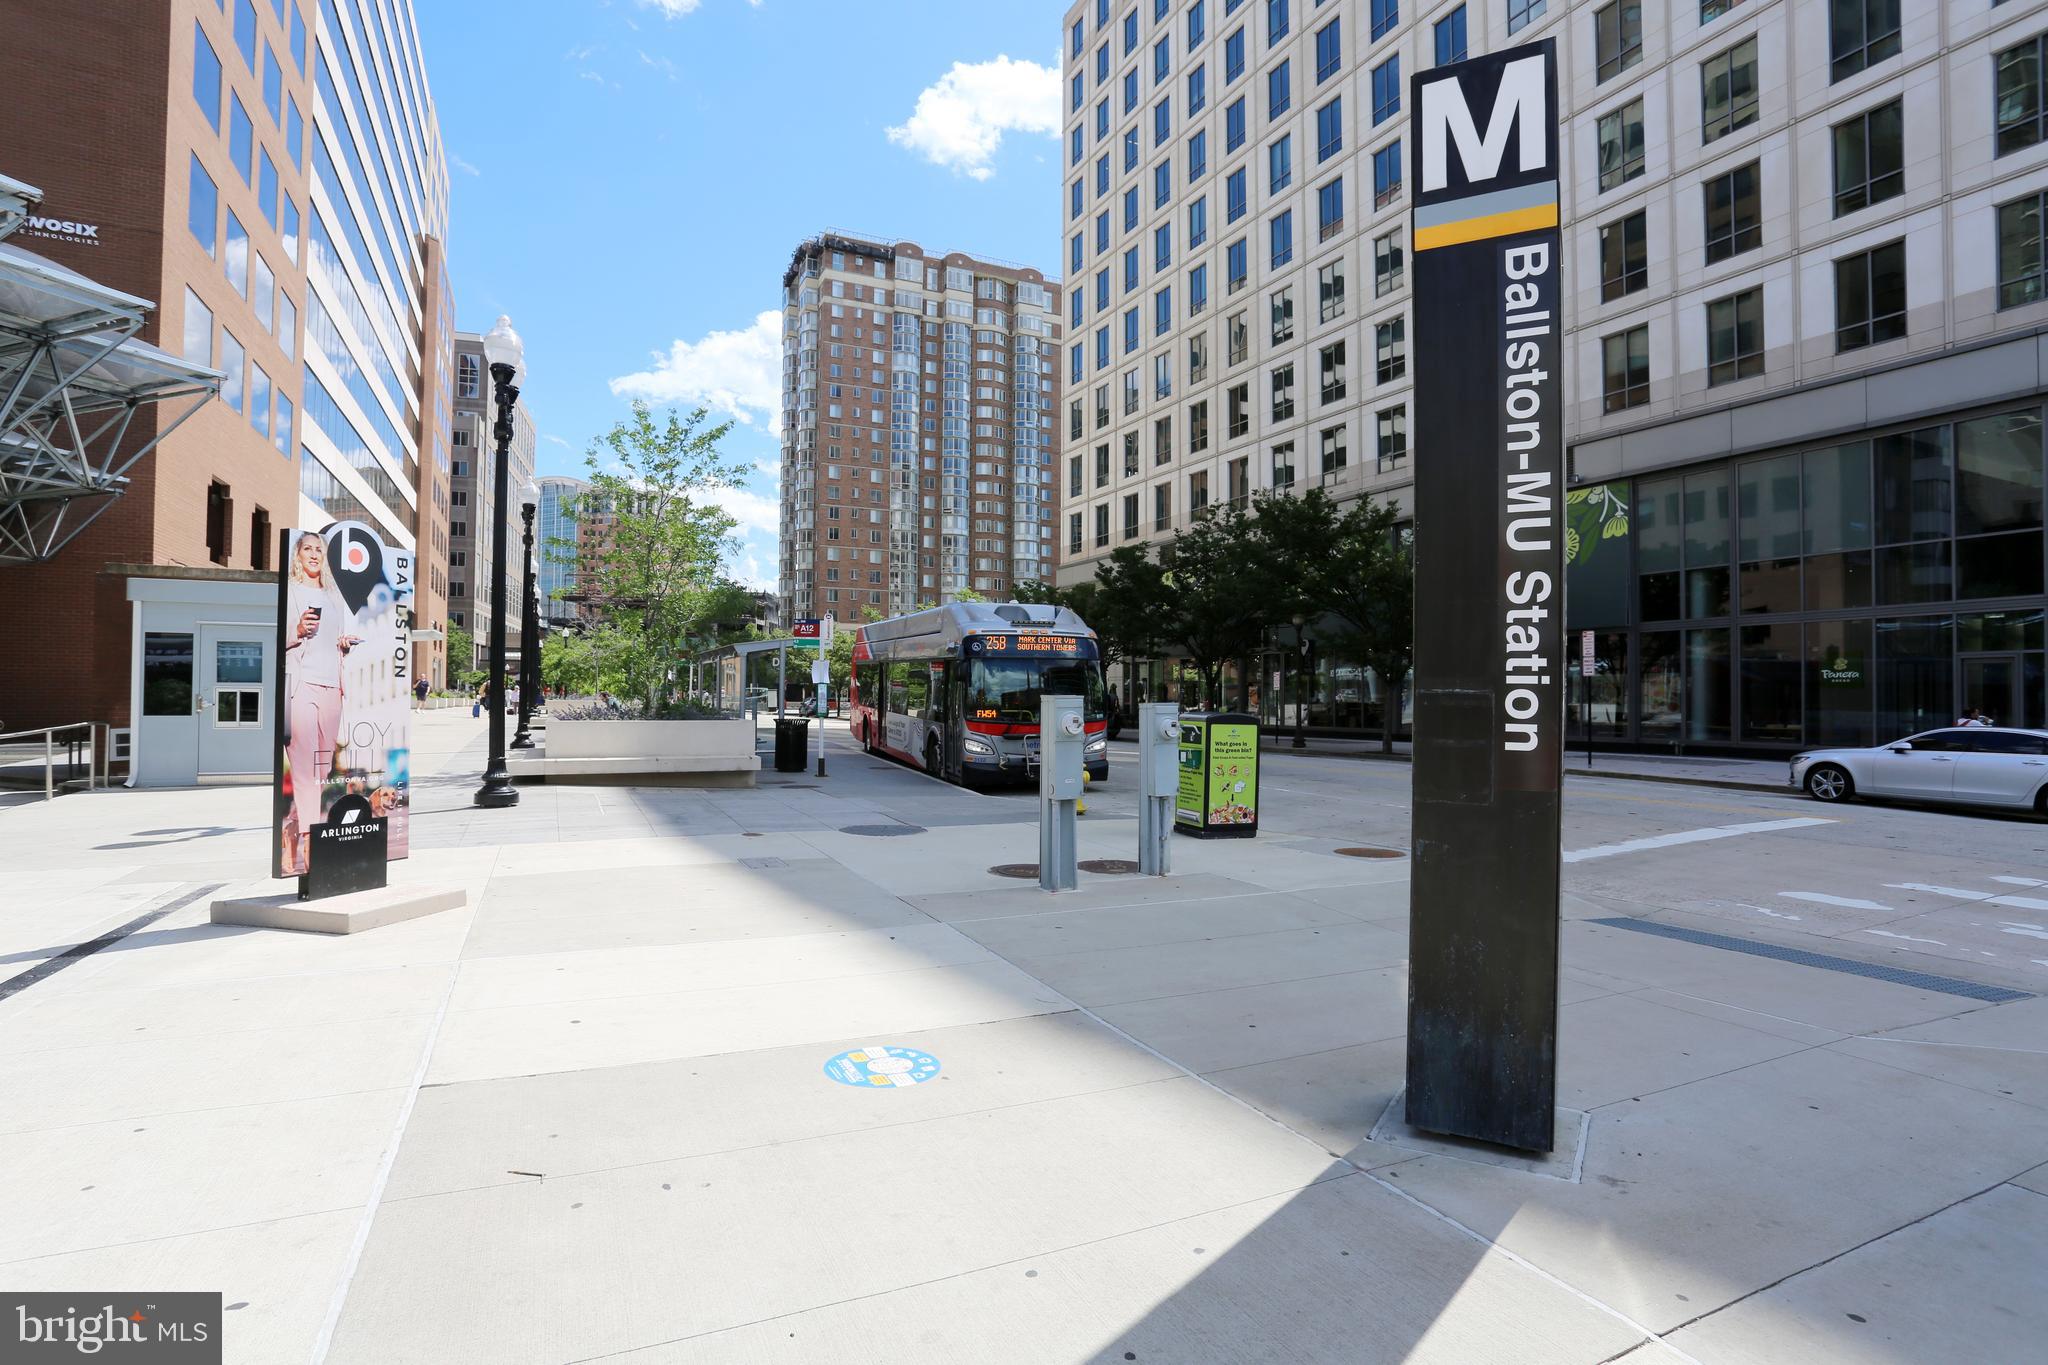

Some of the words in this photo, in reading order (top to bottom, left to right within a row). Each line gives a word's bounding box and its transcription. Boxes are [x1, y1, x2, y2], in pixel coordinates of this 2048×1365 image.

[1422, 54, 1546, 192] M
[14, 228, 100, 246] ECHNOLOGIES
[1505, 242, 1551, 552] Ballston-MU
[394, 557, 409, 678] BALLSTON
[1504, 571, 1551, 752] Station
[1821, 669, 1860, 679] Panera
[320, 823, 380, 838] ARLINGTON
